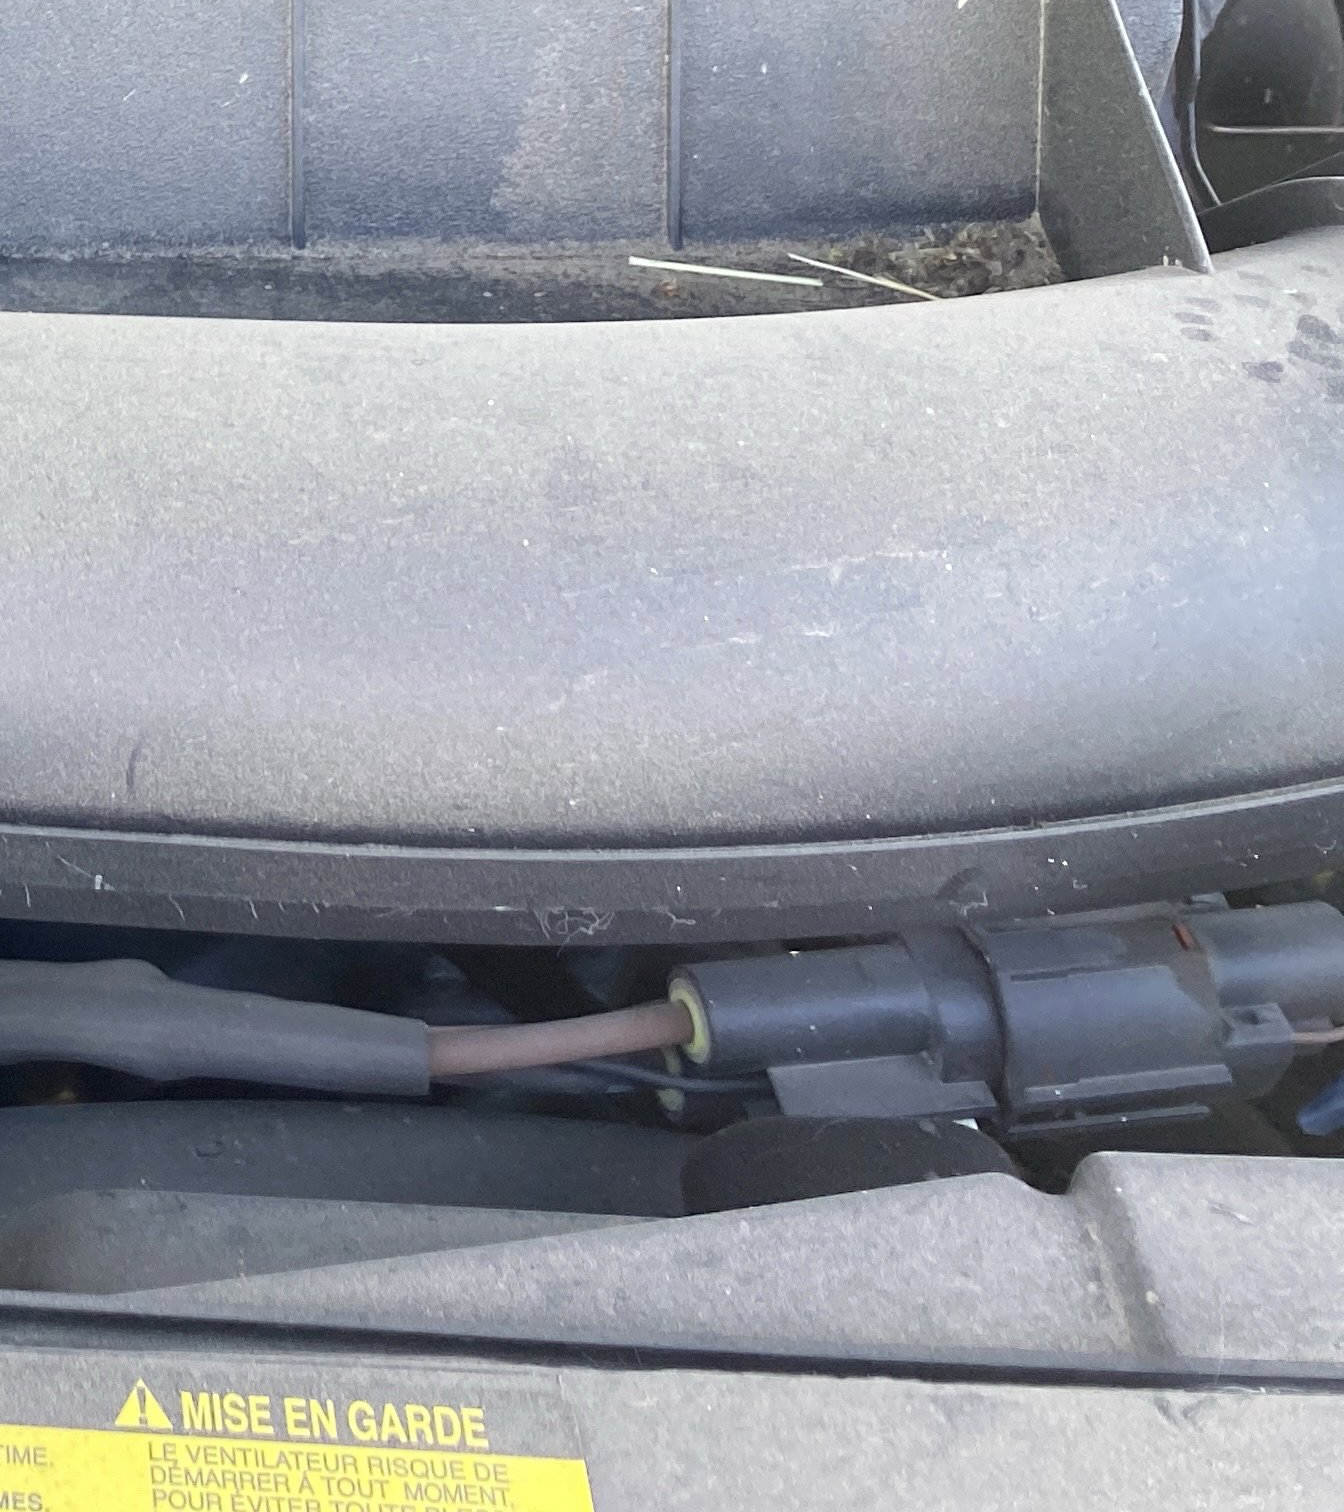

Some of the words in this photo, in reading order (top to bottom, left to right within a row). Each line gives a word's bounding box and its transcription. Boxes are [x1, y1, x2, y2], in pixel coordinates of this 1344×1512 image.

[180, 1390, 274, 1434] MISE
[283, 1395, 338, 1439] EN
[347, 1399, 490, 1448] GARDE
[148, 1441, 177, 1462] LE
[185, 1444, 359, 1475] VENTILATEUR
[367, 1455, 466, 1481] RISQUE
[474, 1461, 511, 1484] DE
[150, 1461, 291, 1493] DÉMARRER
[320, 1476, 390, 1499] TOUT
[151, 1488, 223, 1512] POUR
